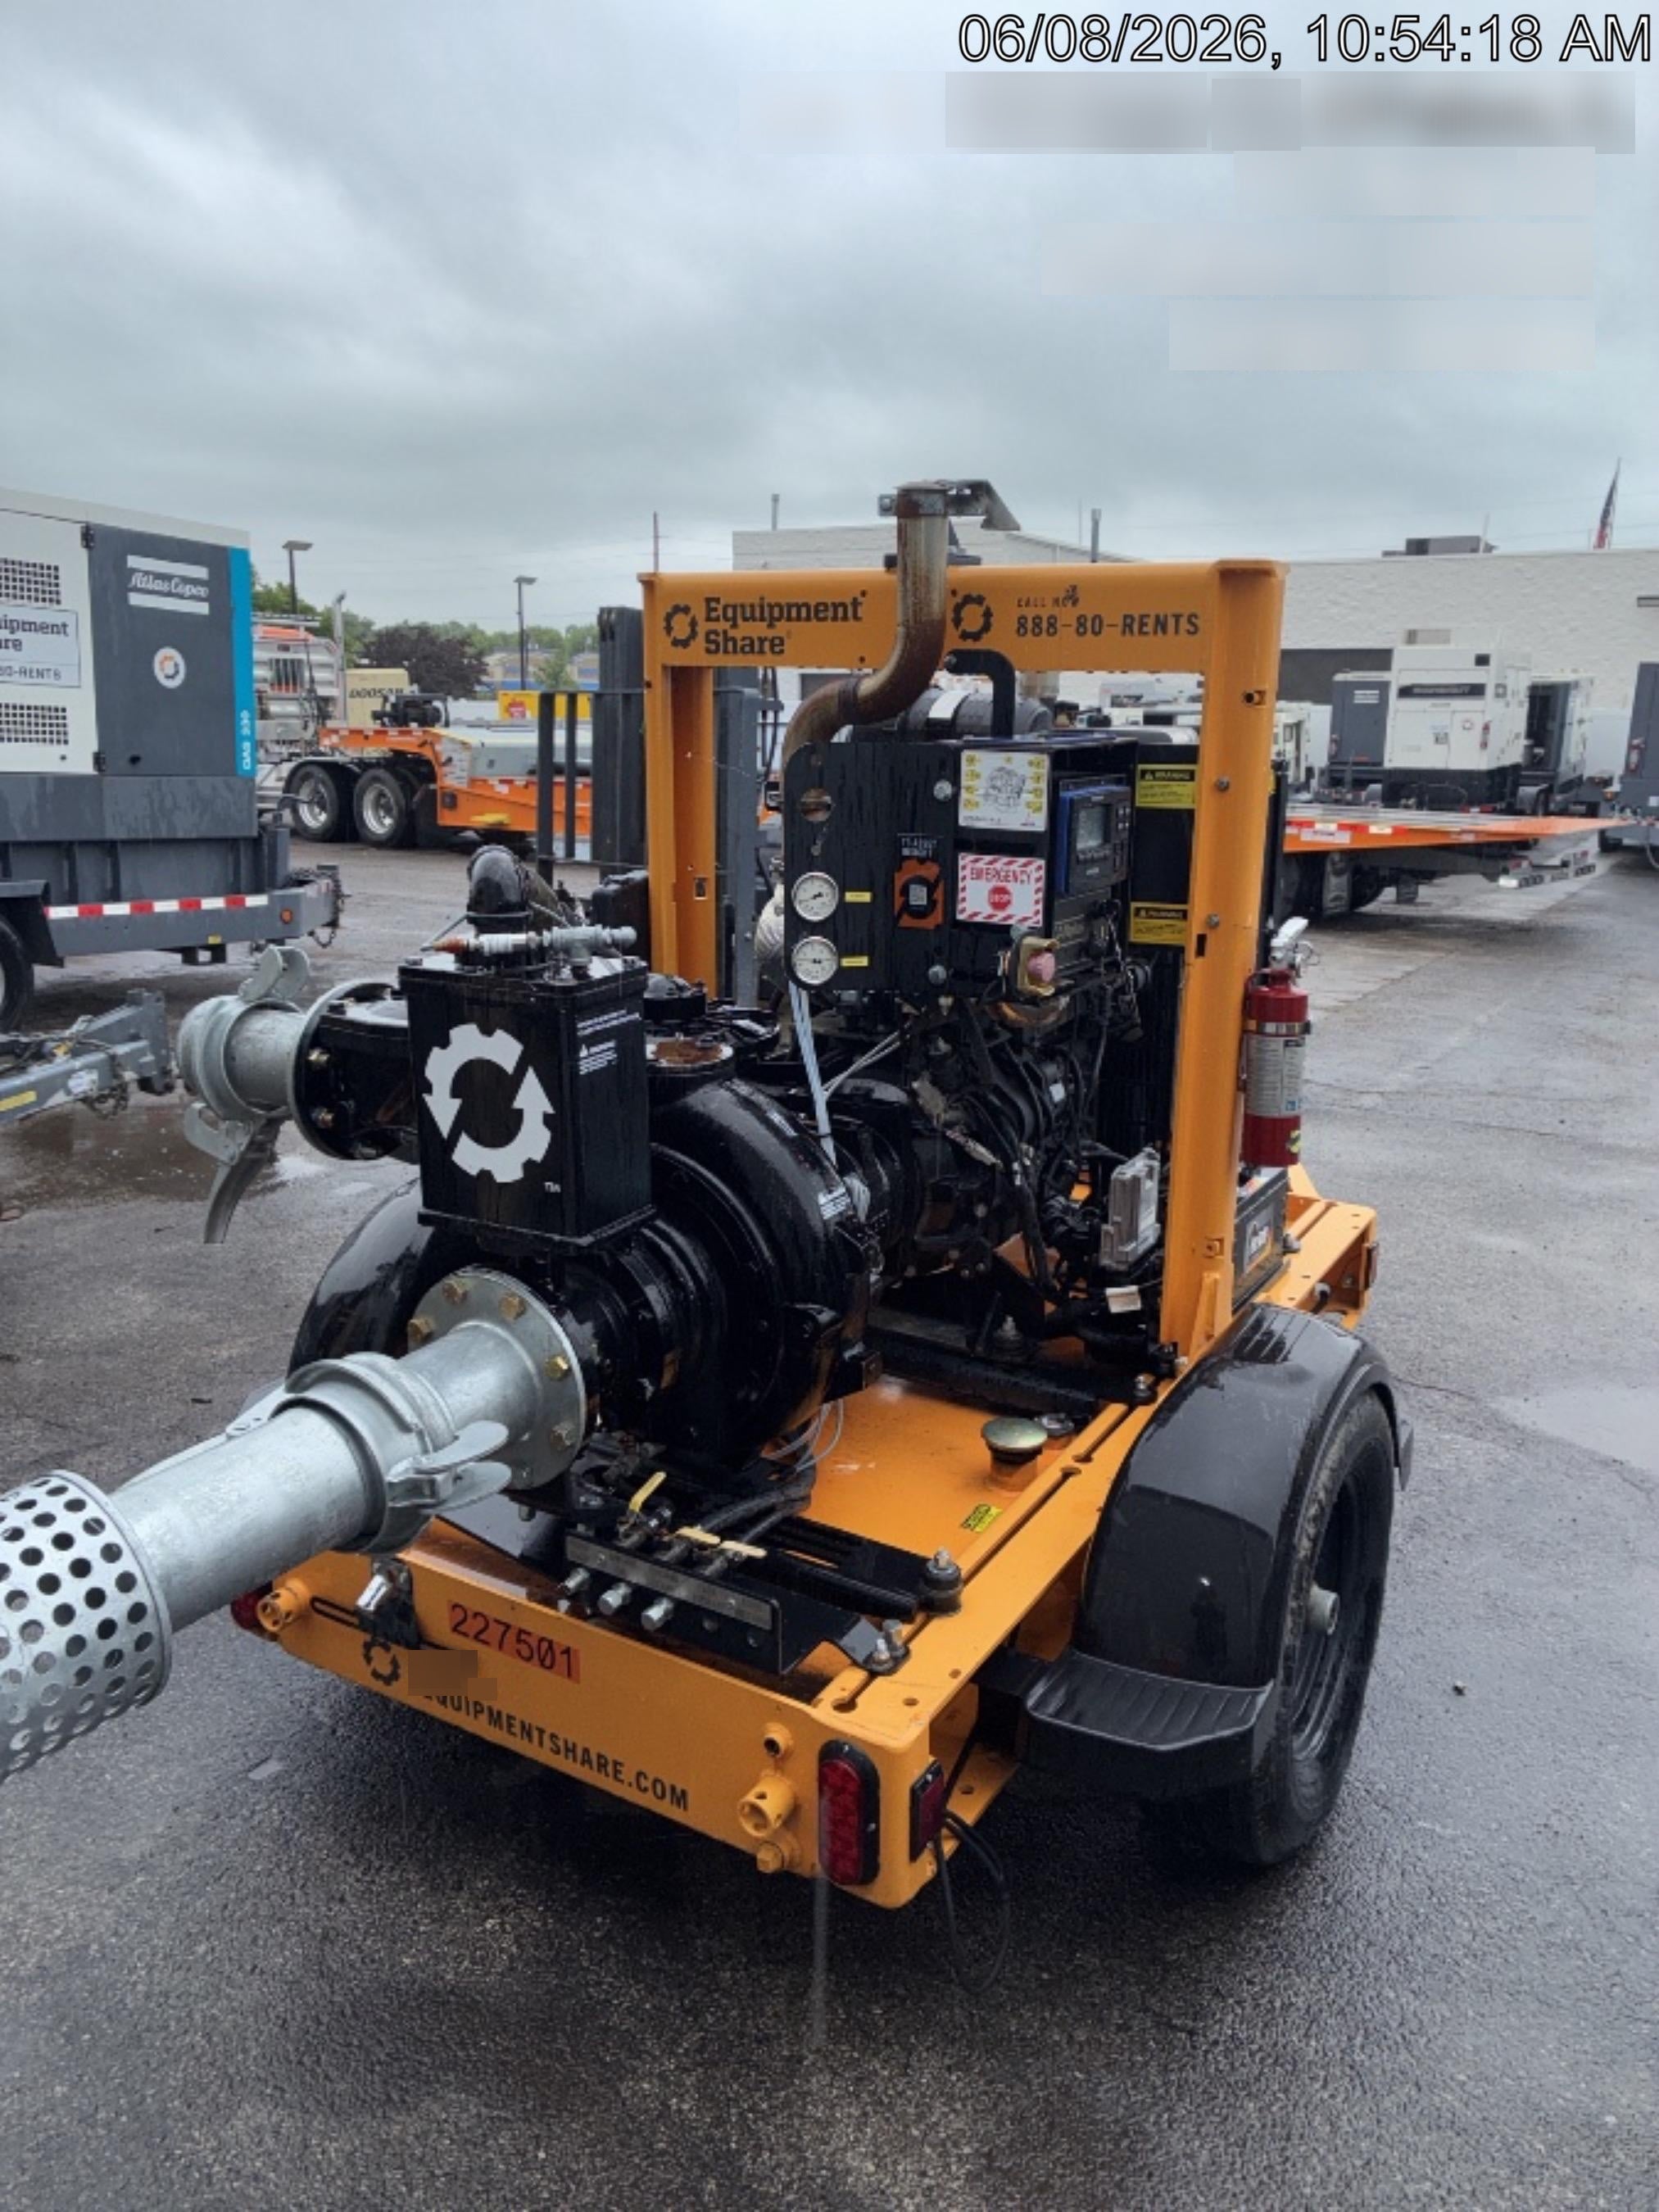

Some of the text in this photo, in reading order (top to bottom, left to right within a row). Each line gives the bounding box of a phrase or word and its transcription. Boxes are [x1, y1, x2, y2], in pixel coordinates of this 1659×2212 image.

[129, 572, 209, 598] Atlas Copco
[705, 596, 863, 629] Equipment
[1017, 596, 1046, 608] CALL
[0, 614, 69, 637] ipment
[1017, 614, 1199, 637] 888-80-RENTS
[705, 629, 785, 655] Share
[970, 867, 1032, 886] EMERGENCY
[451, 1602, 573, 1679] 227501
[424, 1695, 689, 1811] QUIPMENTSHARE.COM
